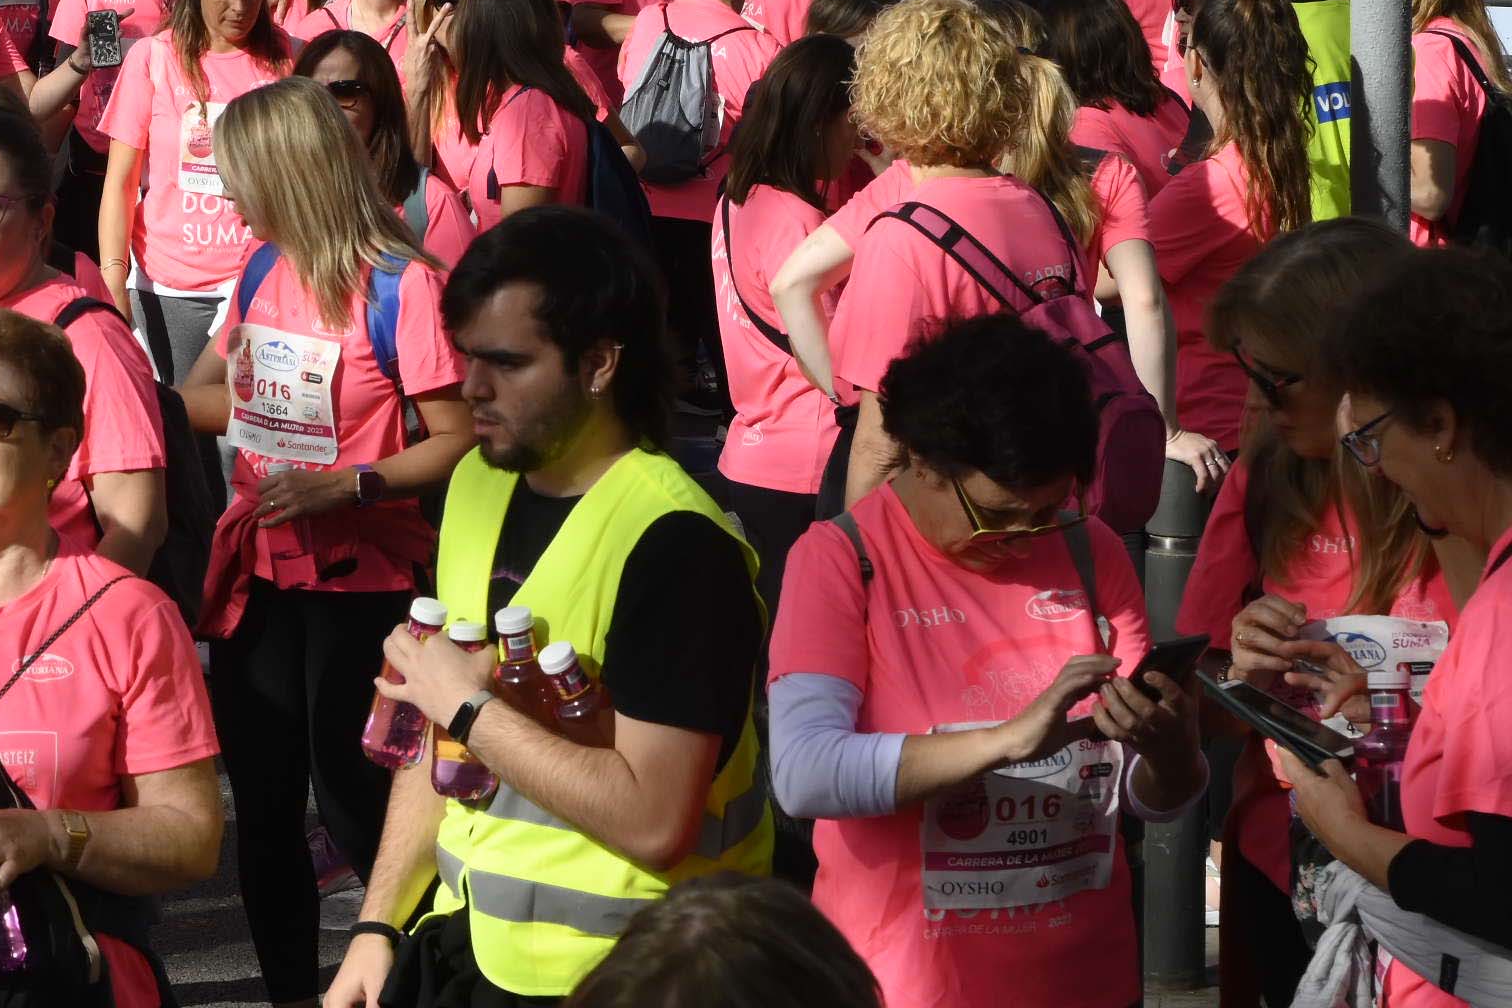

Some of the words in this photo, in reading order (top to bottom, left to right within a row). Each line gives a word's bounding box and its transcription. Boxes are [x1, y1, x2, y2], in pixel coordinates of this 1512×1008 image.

[182, 223, 254, 246] SUMA
[256, 378, 291, 401] 016
[281, 422, 304, 432] MUJER
[288, 440, 327, 453] Santander
[1311, 534, 1355, 554] SHO
[1392, 638, 1430, 649] SUMA
[995, 793, 1063, 822] 016
[1006, 828, 1049, 847] 4901
[947, 856, 1003, 867] CARRERA
[1006, 855, 1023, 865] DE
[1024, 854, 1038, 864] LA
[941, 881, 1005, 897] OYSHO
